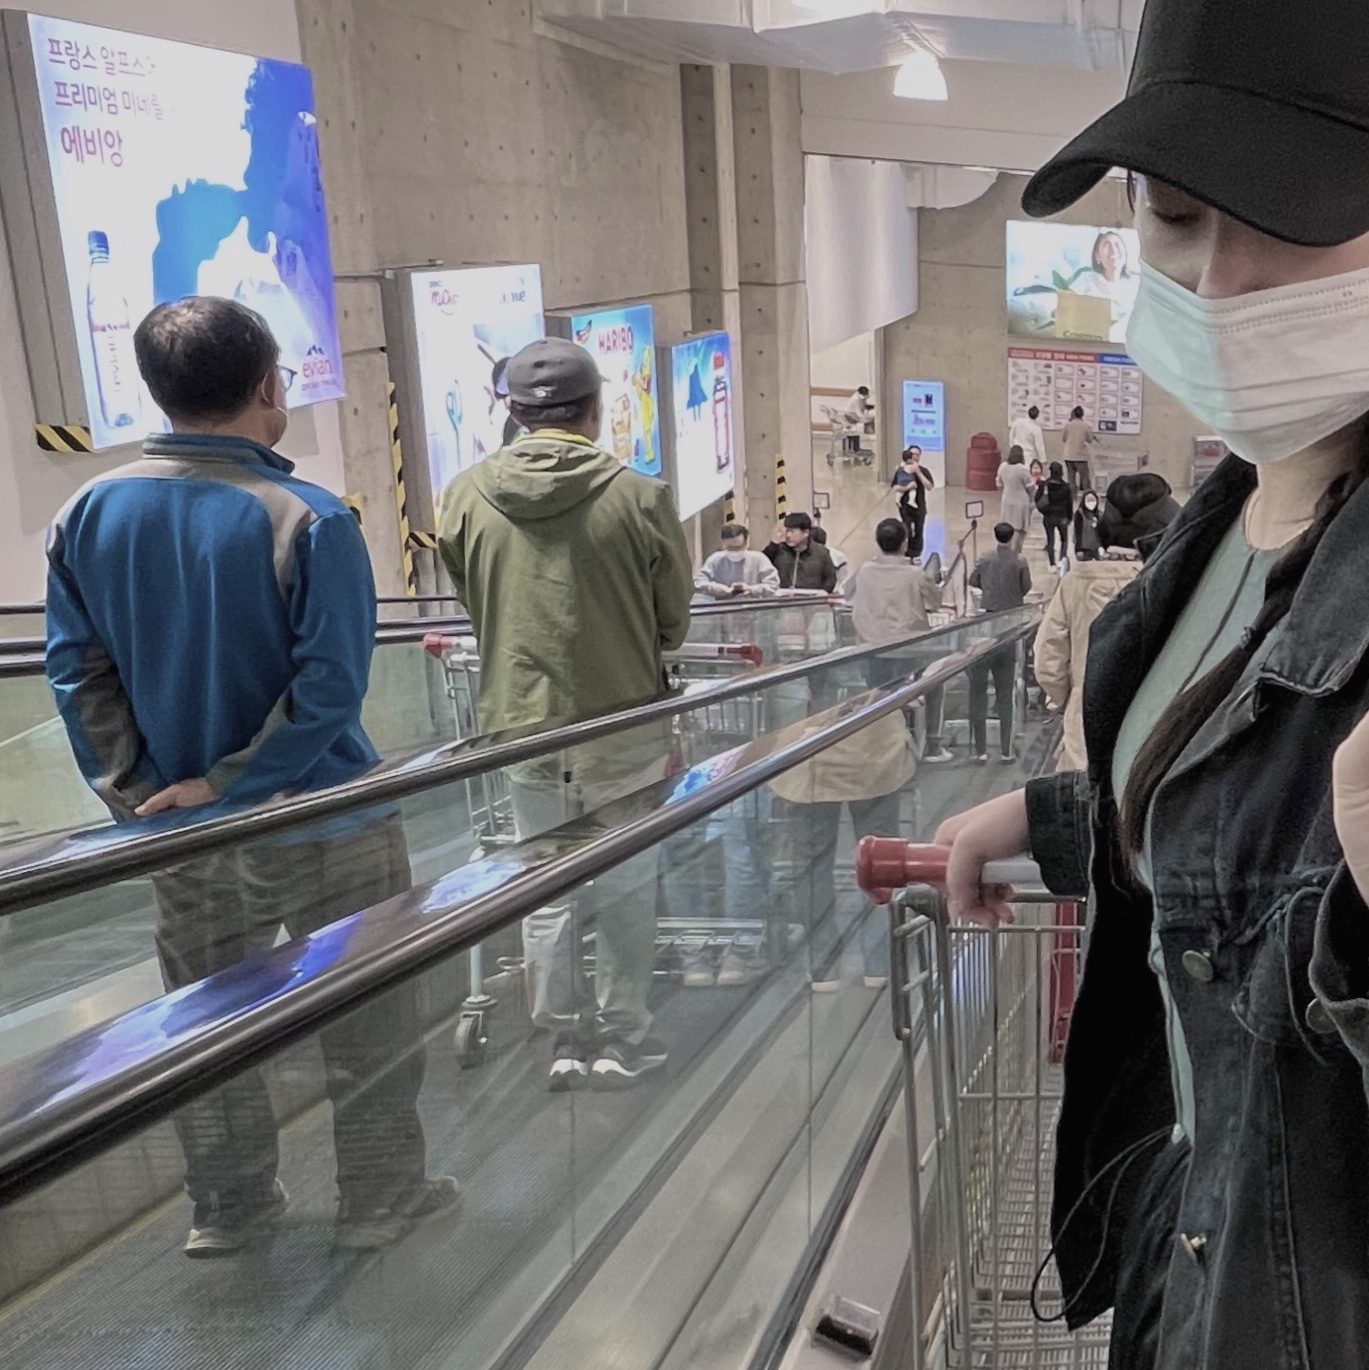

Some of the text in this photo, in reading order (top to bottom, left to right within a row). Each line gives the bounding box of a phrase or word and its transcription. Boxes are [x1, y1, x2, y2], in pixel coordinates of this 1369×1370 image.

[48, 38, 98, 70] 프랑스
[54, 81, 119, 115] 프리미엄
[60, 125, 123, 167] 에비앙
[599, 325, 634, 355] HARIBO
